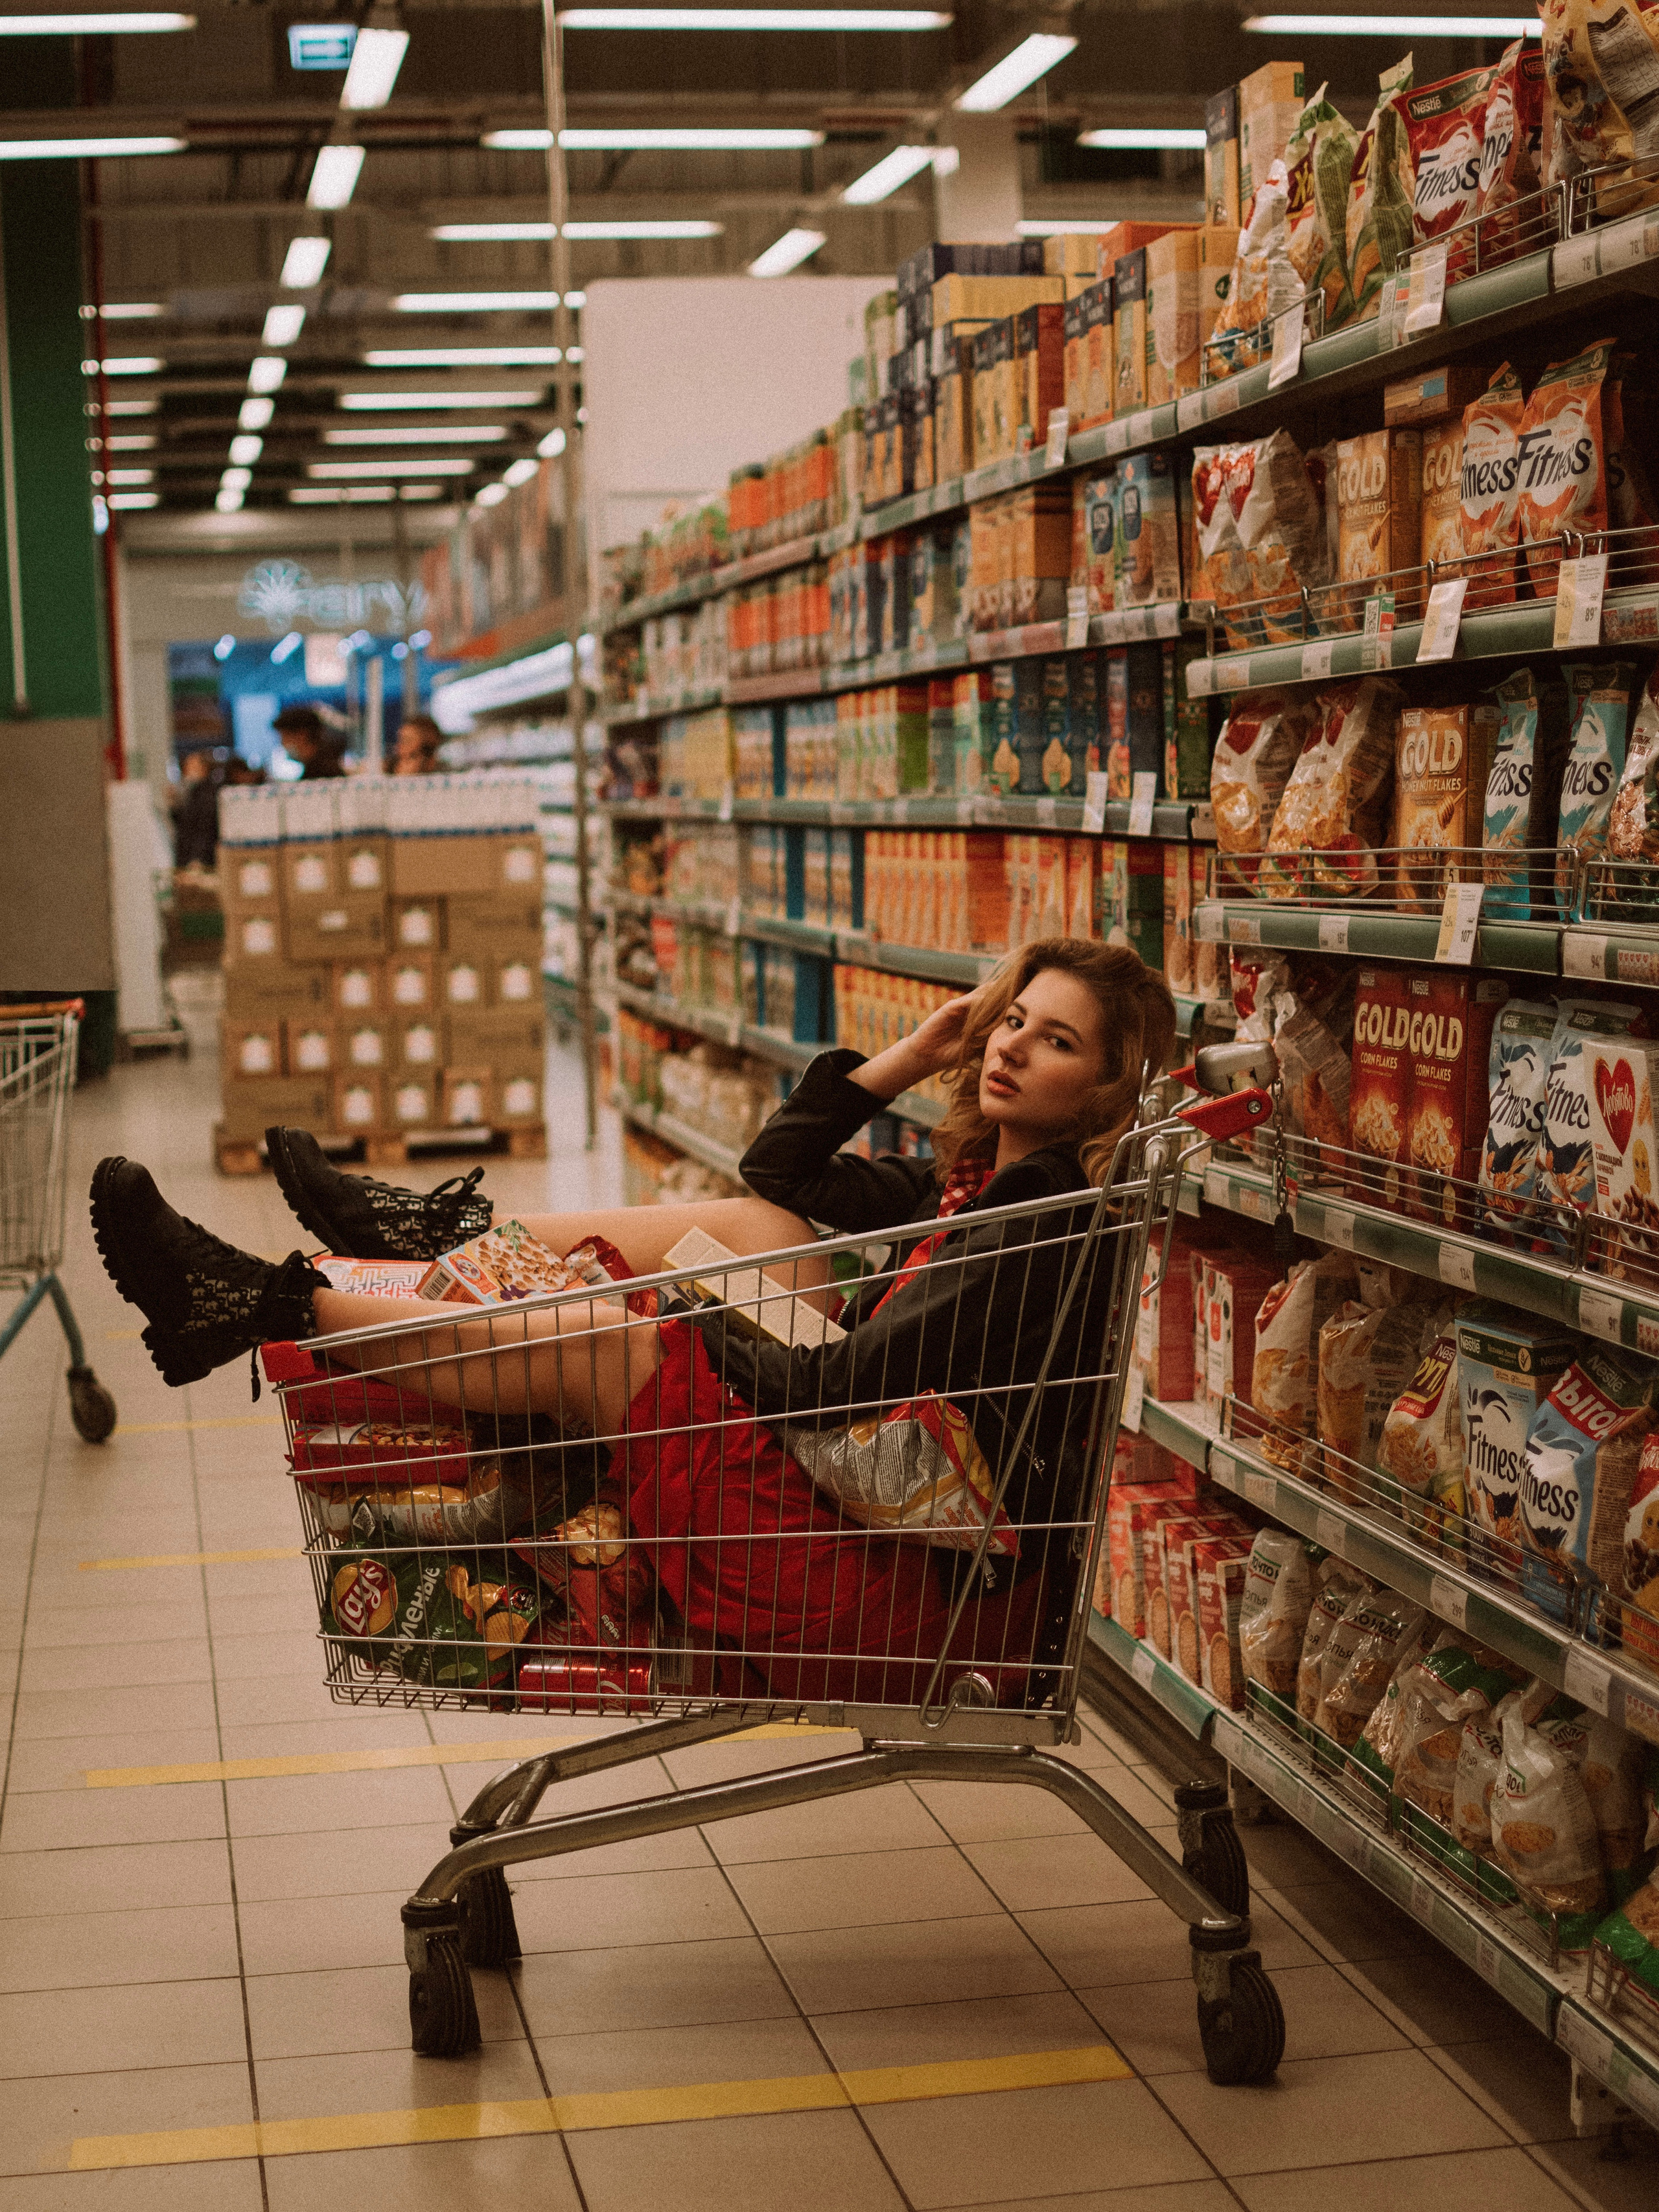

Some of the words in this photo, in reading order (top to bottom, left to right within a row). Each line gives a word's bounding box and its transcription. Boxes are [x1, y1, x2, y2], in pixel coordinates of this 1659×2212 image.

[1415, 154, 1481, 207] Fitness
[1338, 454, 1387, 506] GOLD
[1424, 441, 1461, 491] GOL
[1518, 428, 1592, 489] Fitness
[1402, 729, 1463, 777] GOLD
[1420, 779, 1432, 791] NUT
[1433, 778, 1461, 791] FLAKES
[1355, 1002, 1410, 1051] GOLD
[1410, 1011, 1463, 1062] GOLD
[1361, 1052, 1375, 1065] CORN
[1376, 1054, 1398, 1069] FLAKES
[1415, 1064, 1430, 1077] CORN
[1430, 1066, 1451, 1082] FLAKES
[1491, 1069, 1545, 1132] Fitness
[1547, 1063, 1590, 1130] Fitnes
[1467, 1415, 1521, 1484] Fitnes
[338, 1566, 384, 1635] Lay's
